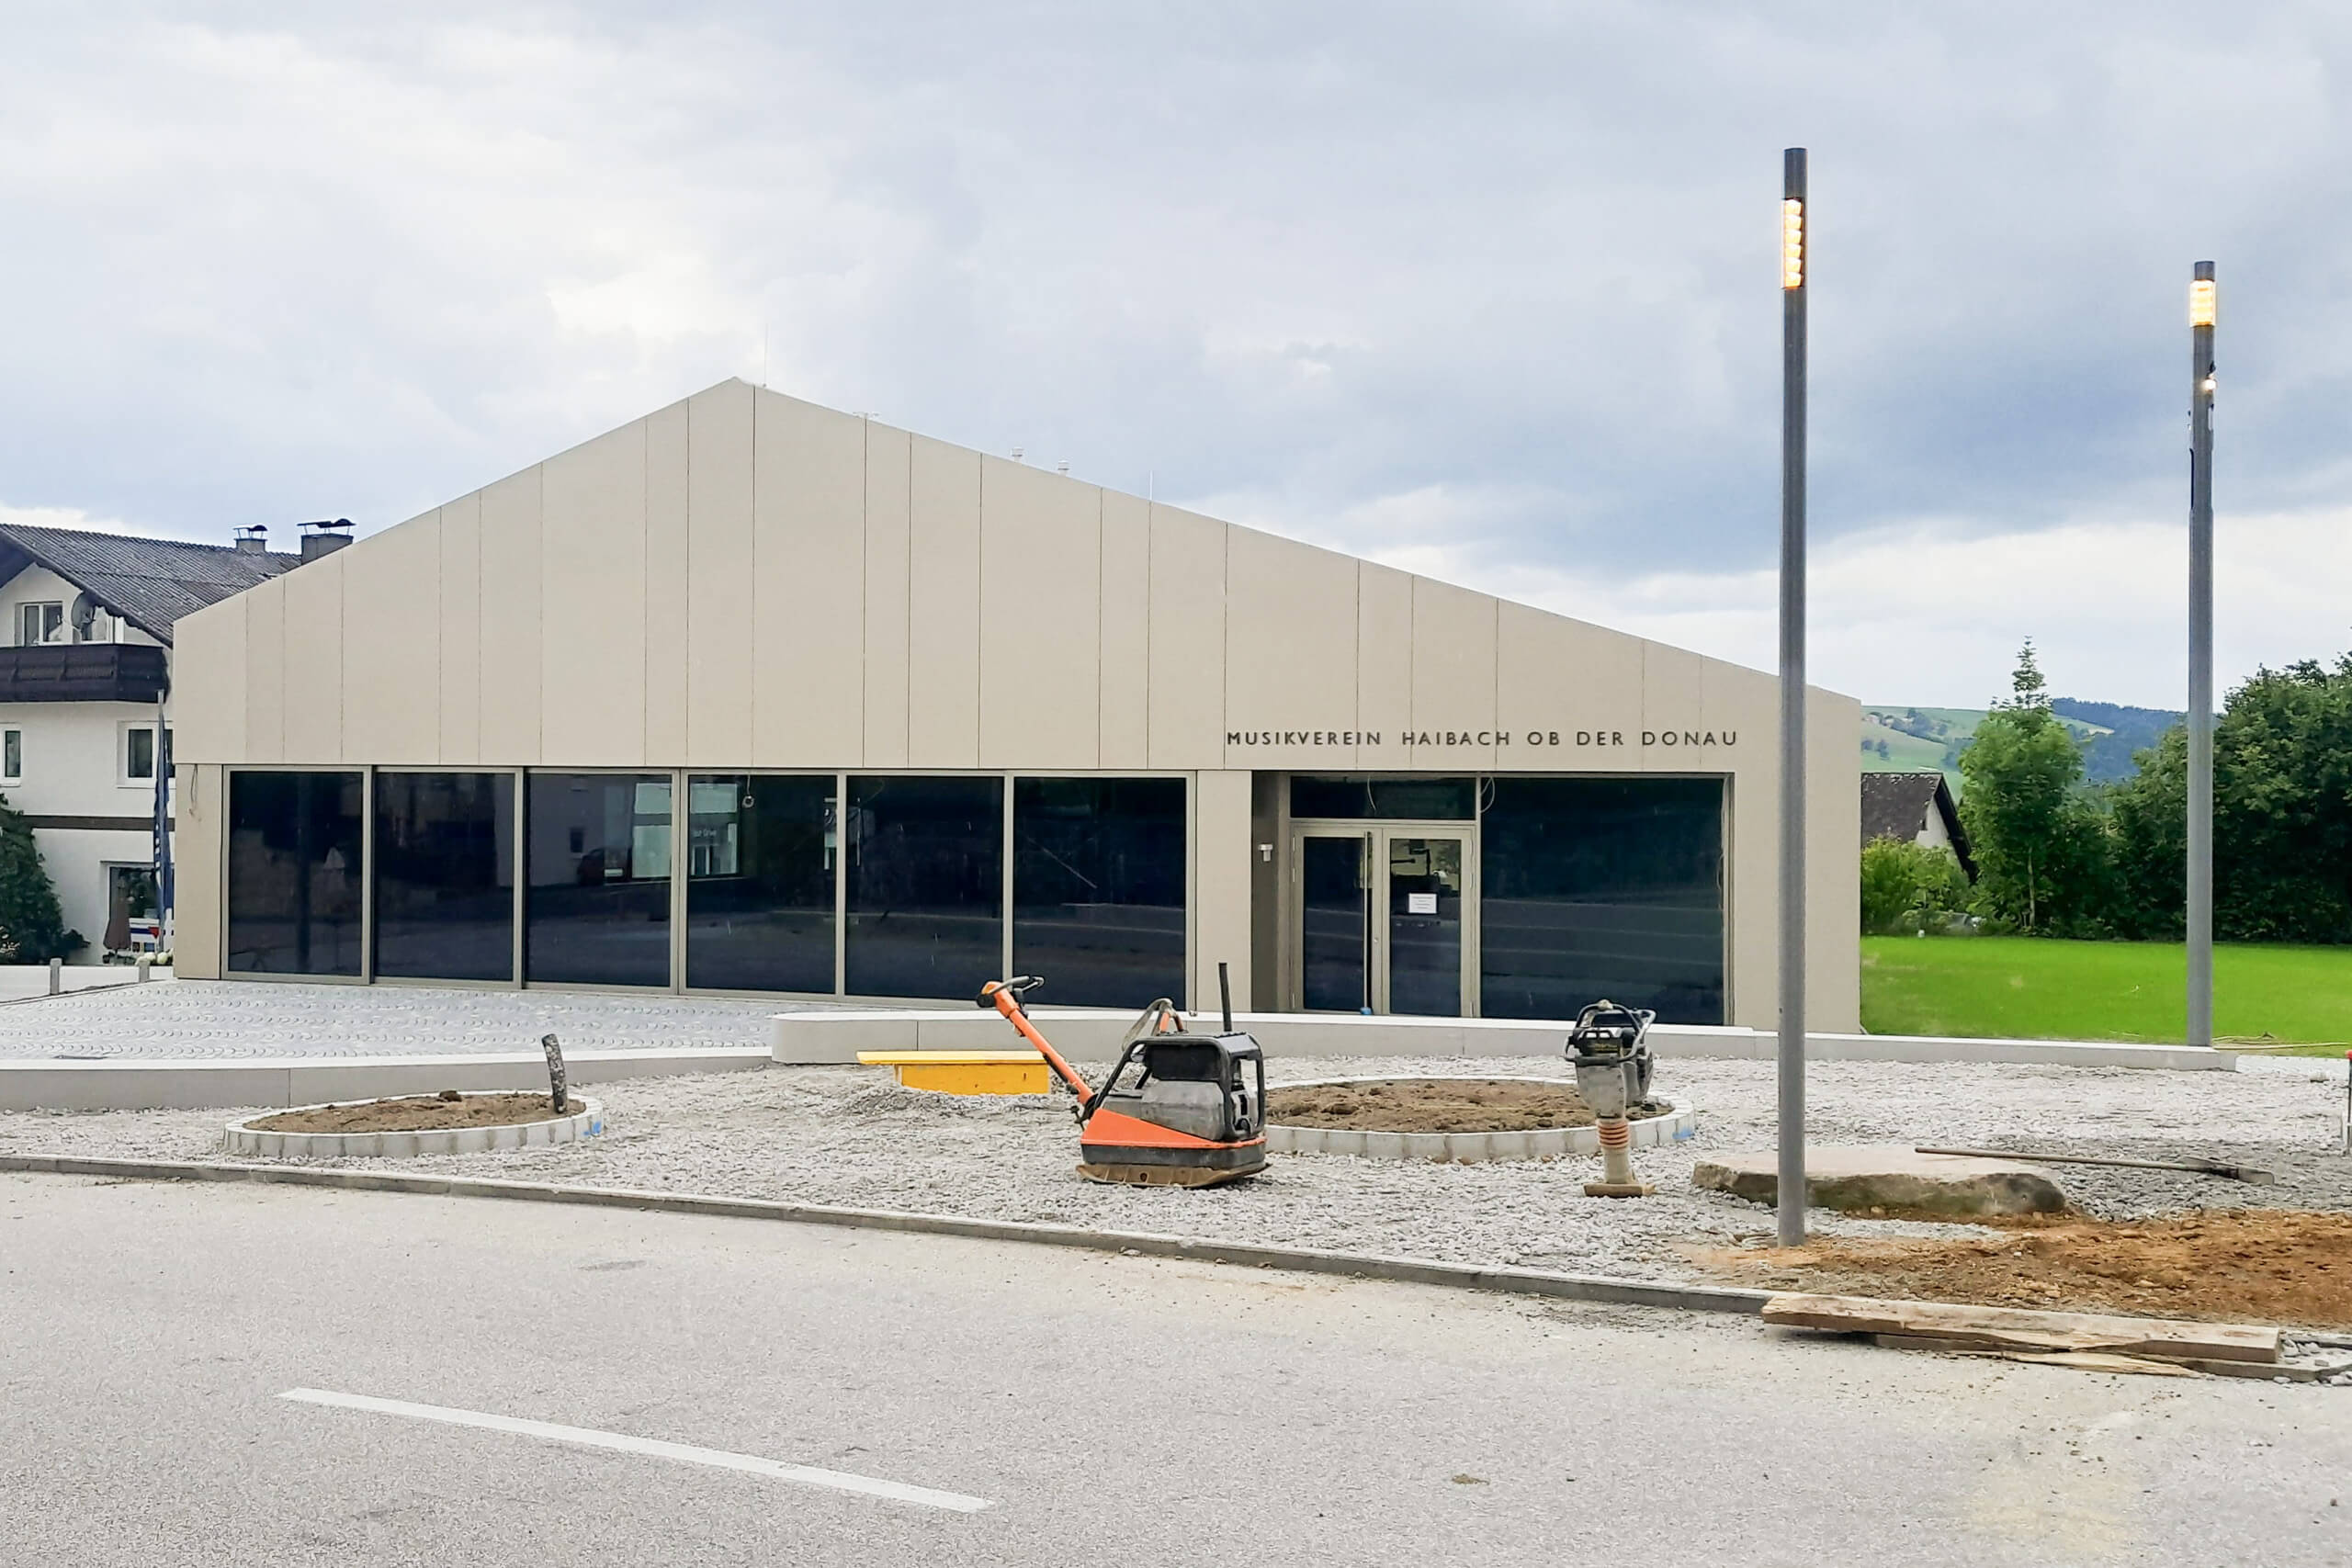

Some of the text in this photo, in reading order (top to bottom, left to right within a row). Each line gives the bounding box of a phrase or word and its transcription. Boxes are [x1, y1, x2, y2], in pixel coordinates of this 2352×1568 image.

[1227, 731, 1736, 745] MUSIKVEREIN HAIBACH OB DER DONAU
